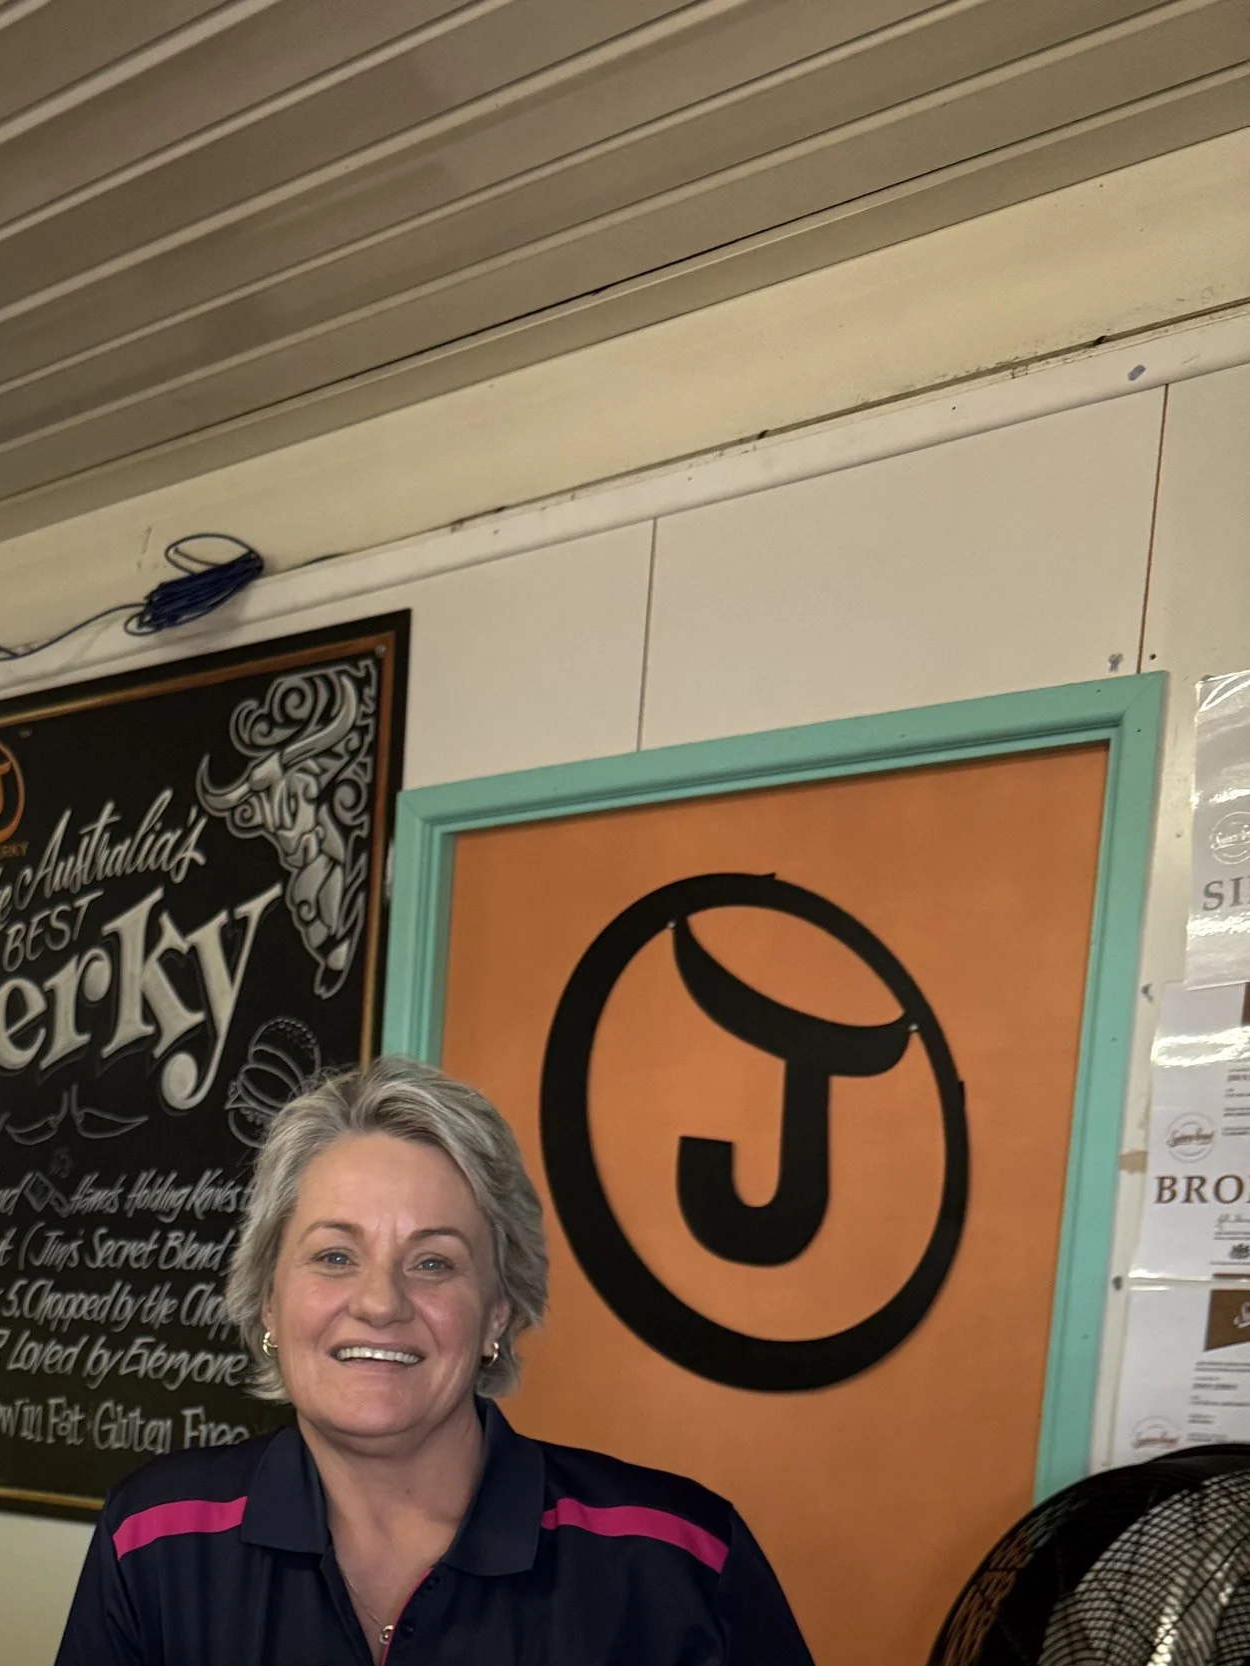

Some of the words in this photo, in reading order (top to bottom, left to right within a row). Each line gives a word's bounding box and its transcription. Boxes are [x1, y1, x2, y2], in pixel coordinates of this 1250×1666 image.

[13, 788, 208, 911] Australia's
[2, 889, 104, 972] BEST
[1154, 1175, 1250, 1204] BRO
[84, 1228, 161, 1270] Secret
[157, 1228, 237, 1271] Blend
[141, 1281, 179, 1329] the
[7, 1330, 89, 1375] Loved
[82, 1336, 124, 1390] by
[118, 1336, 249, 1391] Everyone
[46, 1396, 86, 1446] Fat
[181, 1406, 250, 1450] Free
